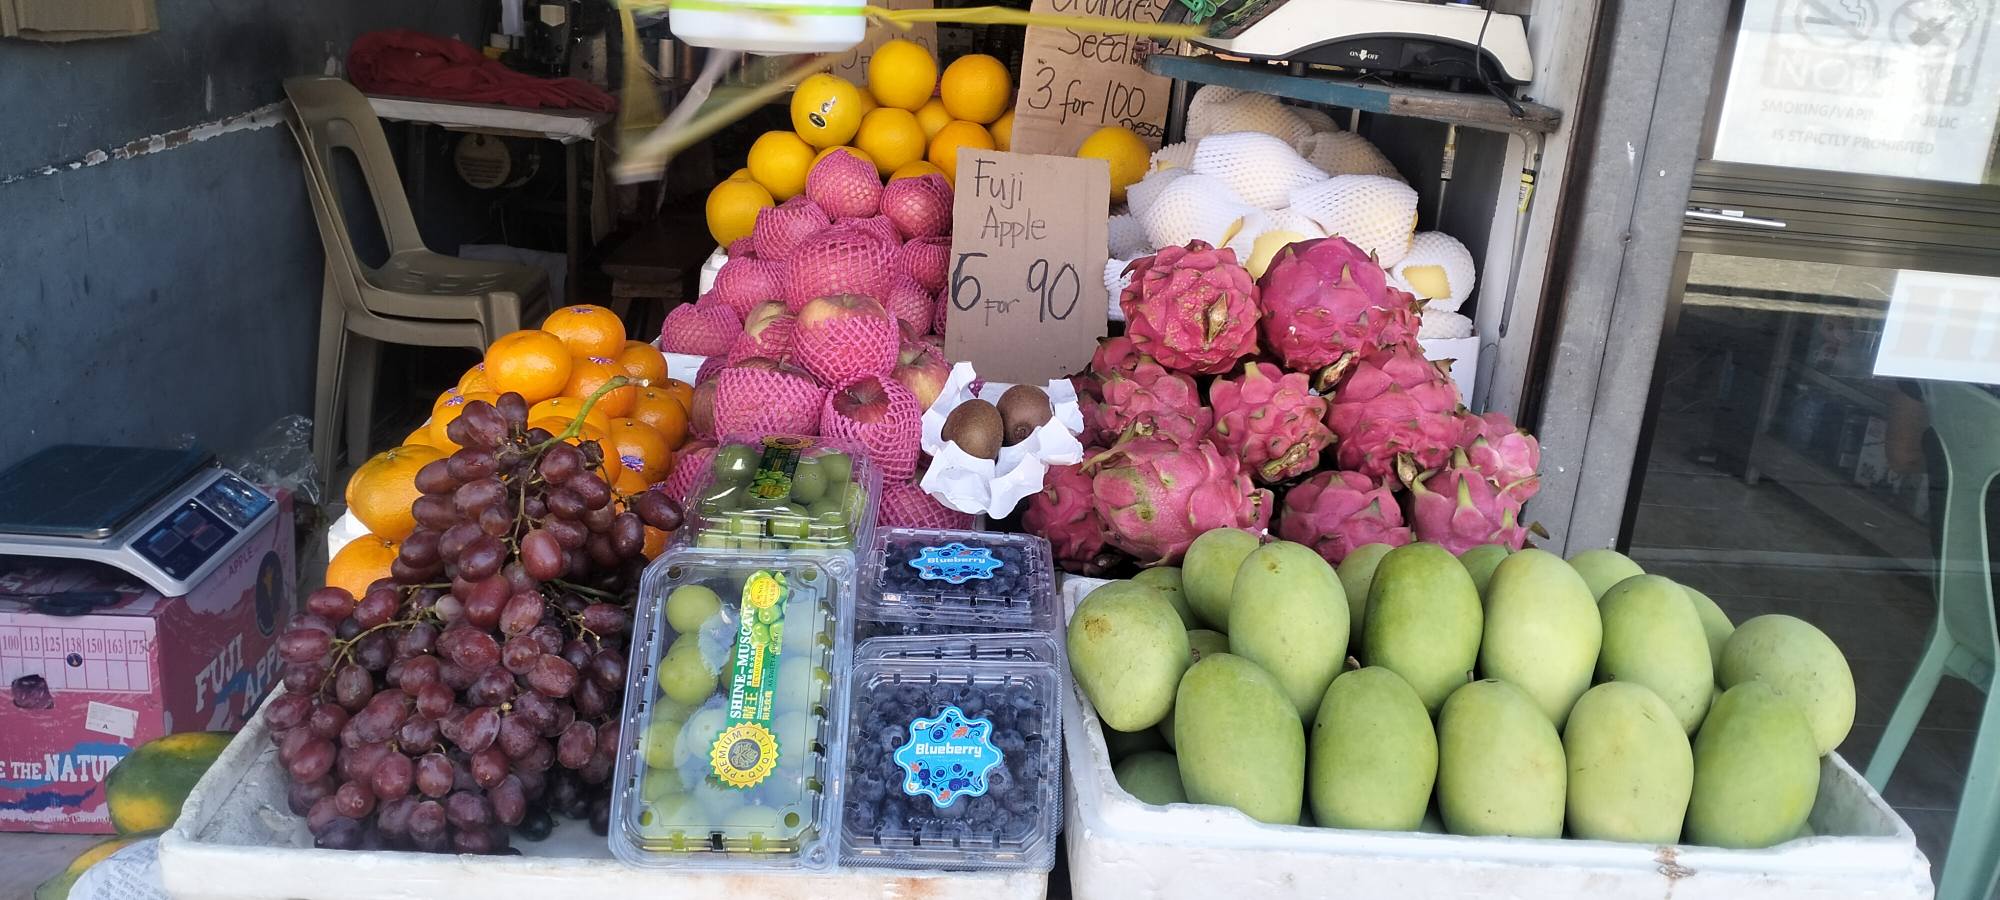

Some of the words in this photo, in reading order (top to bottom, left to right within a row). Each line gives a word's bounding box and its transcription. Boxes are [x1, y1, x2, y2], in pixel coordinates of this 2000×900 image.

[1028, 66, 1056, 109] 3
[1059, 79, 1094, 125] for
[1100, 80, 1146, 124] 100
[1788, 130, 1850, 148] STRICTLY
[975, 158, 1024, 210] Fuji
[981, 205, 1048, 249] Apple
[1027, 258, 1080, 323] 90
[3, 635, 19, 650] 100
[24, 636, 40, 651] 113
[44, 637, 61, 652] 125
[66, 637, 82, 653] 138
[87, 638, 102, 653] 150
[107, 639, 123, 654] 163
[128, 640, 144, 655] 175
[730, 608, 755, 718] SHINE-MUSCAT
[195, 632, 244, 713] FUJI
[242, 630, 287, 716] APPL
[10, 762, 42, 780] THE
[44, 753, 125, 783] NATUR
[718, 730, 742, 778] PREMIUM
[915, 742, 982, 758] Blueberry
